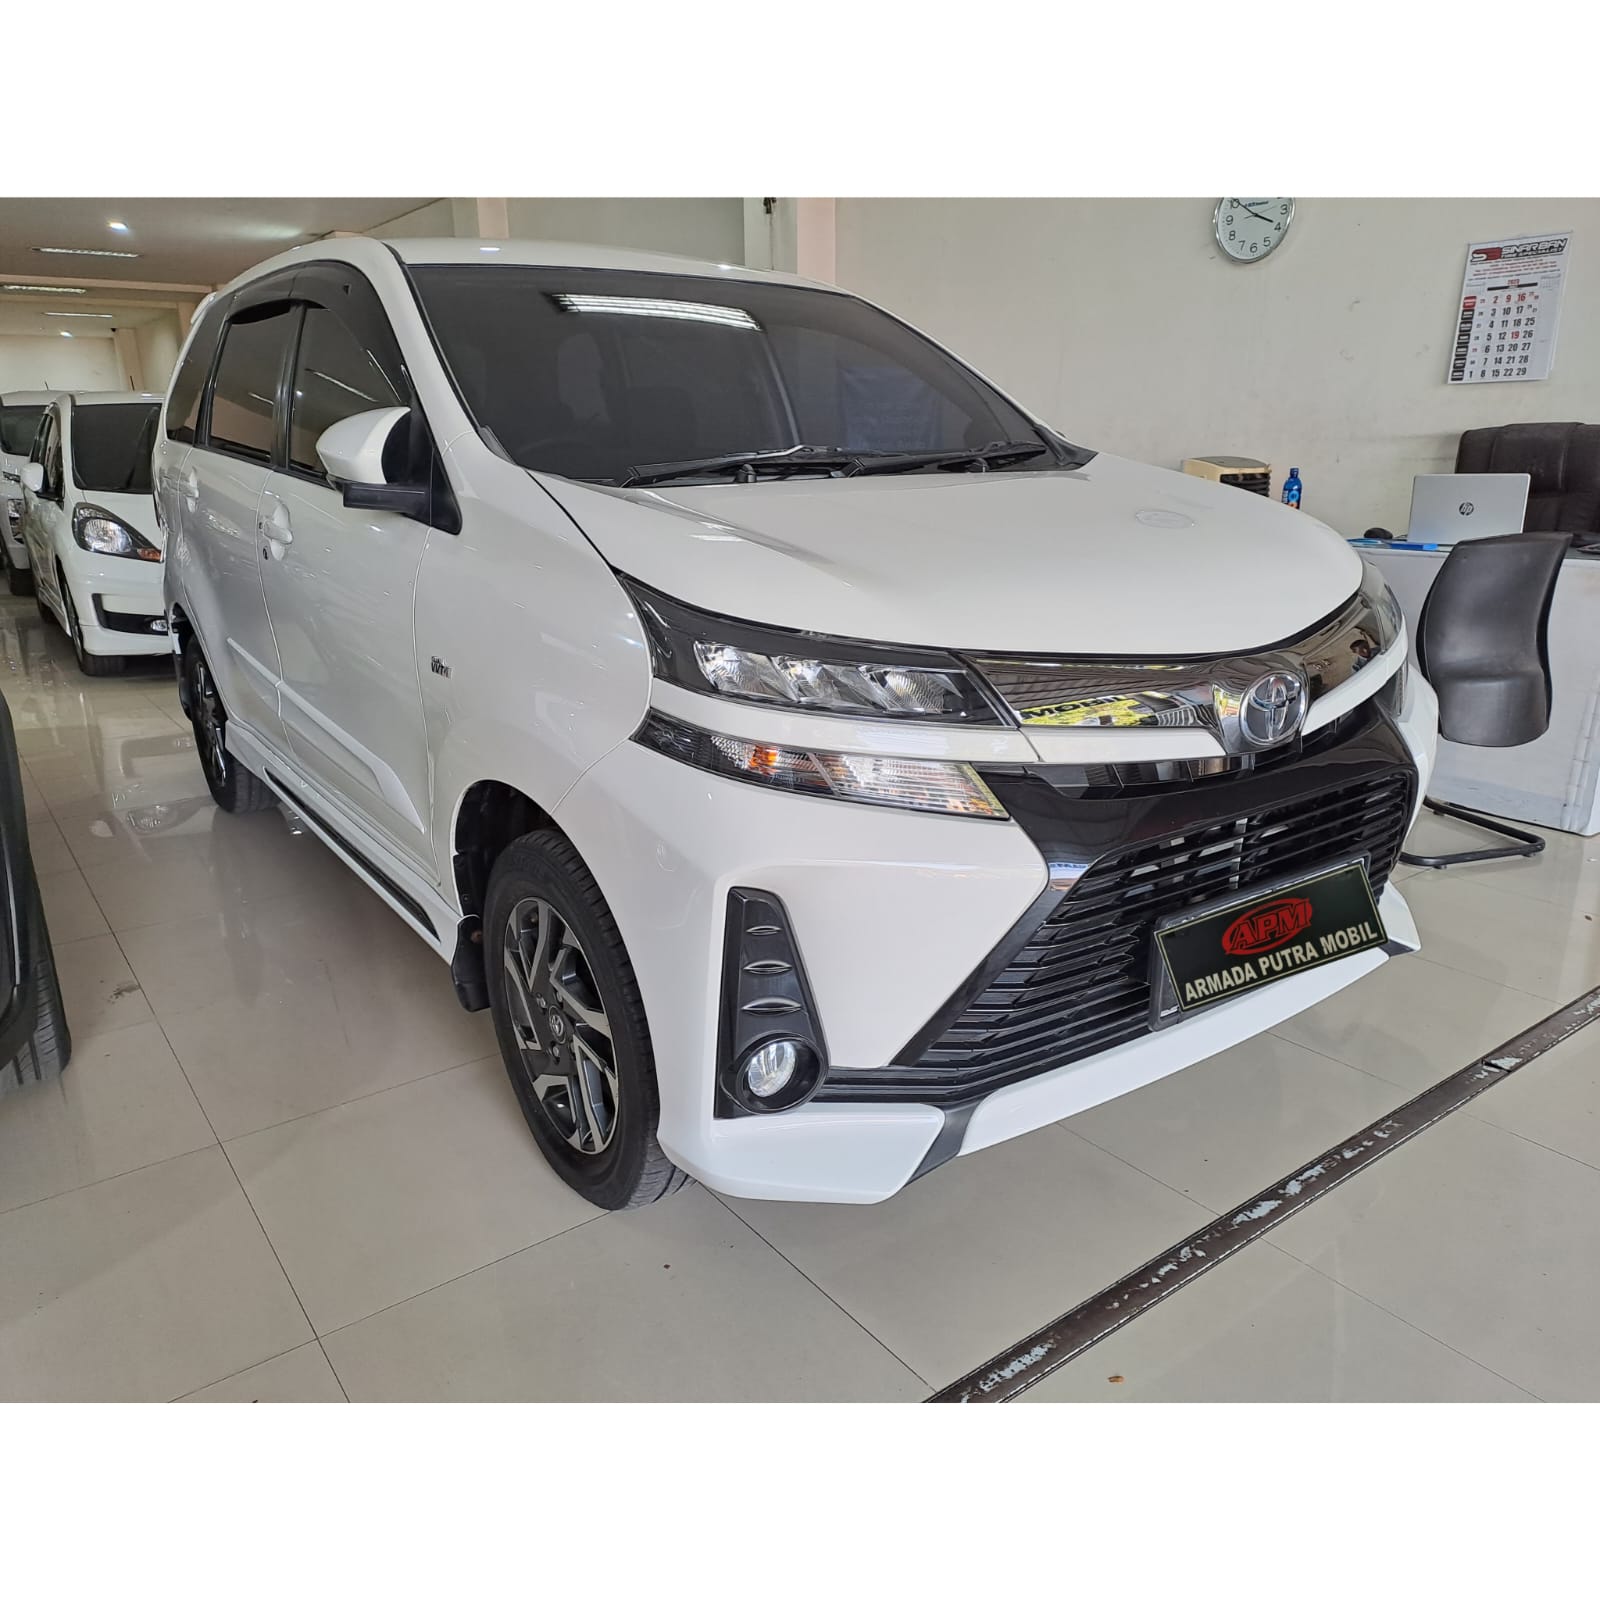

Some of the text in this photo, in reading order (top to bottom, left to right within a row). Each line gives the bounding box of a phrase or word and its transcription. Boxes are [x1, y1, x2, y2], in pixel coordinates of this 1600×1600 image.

[1280, 204, 1288, 215] 3
[1226, 215, 1233, 225] 9
[1274, 222, 1281, 231] 4
[1229, 230, 1236, 240] 8
[1239, 241, 1245, 251] 7
[1264, 237, 1271, 247] 5
[1250, 243, 1257, 253] 6
[1493, 295, 1499, 304] 2
[1505, 294, 1511, 303] 9
[1517, 293, 1526, 302] 16
[1490, 308, 1496, 317] 3
[1503, 306, 1511, 316] 10
[1516, 305, 1524, 314] 17
[1489, 320, 1494, 329] 4
[1501, 319, 1509, 328] 11
[1513, 318, 1521, 327] 18
[1524, 316, 1535, 326] 25
[1486, 332, 1492, 341] 5
[1498, 331, 1507, 340] 12
[1511, 330, 1520, 340] 19
[1522, 329, 1534, 339] 26
[1484, 344, 1490, 353] 6
[1496, 343, 1504, 353] 13
[1507, 342, 1518, 351] 20
[1520, 342, 1531, 351] 27
[1482, 357, 1488, 366] 7
[1494, 356, 1502, 365] 14
[1505, 355, 1515, 364] 21
[1518, 354, 1529, 364] 28
[1480, 369, 1486, 378] 8
[1491, 368, 1500, 377] 15
[1503, 367, 1513, 377] 22
[1515, 366, 1527, 376] 29
[1459, 501, 1475, 517] hp
[1231, 901, 1312, 951] APM
[1184, 921, 1378, 1002] ARMADA PUTRA MOBIL
